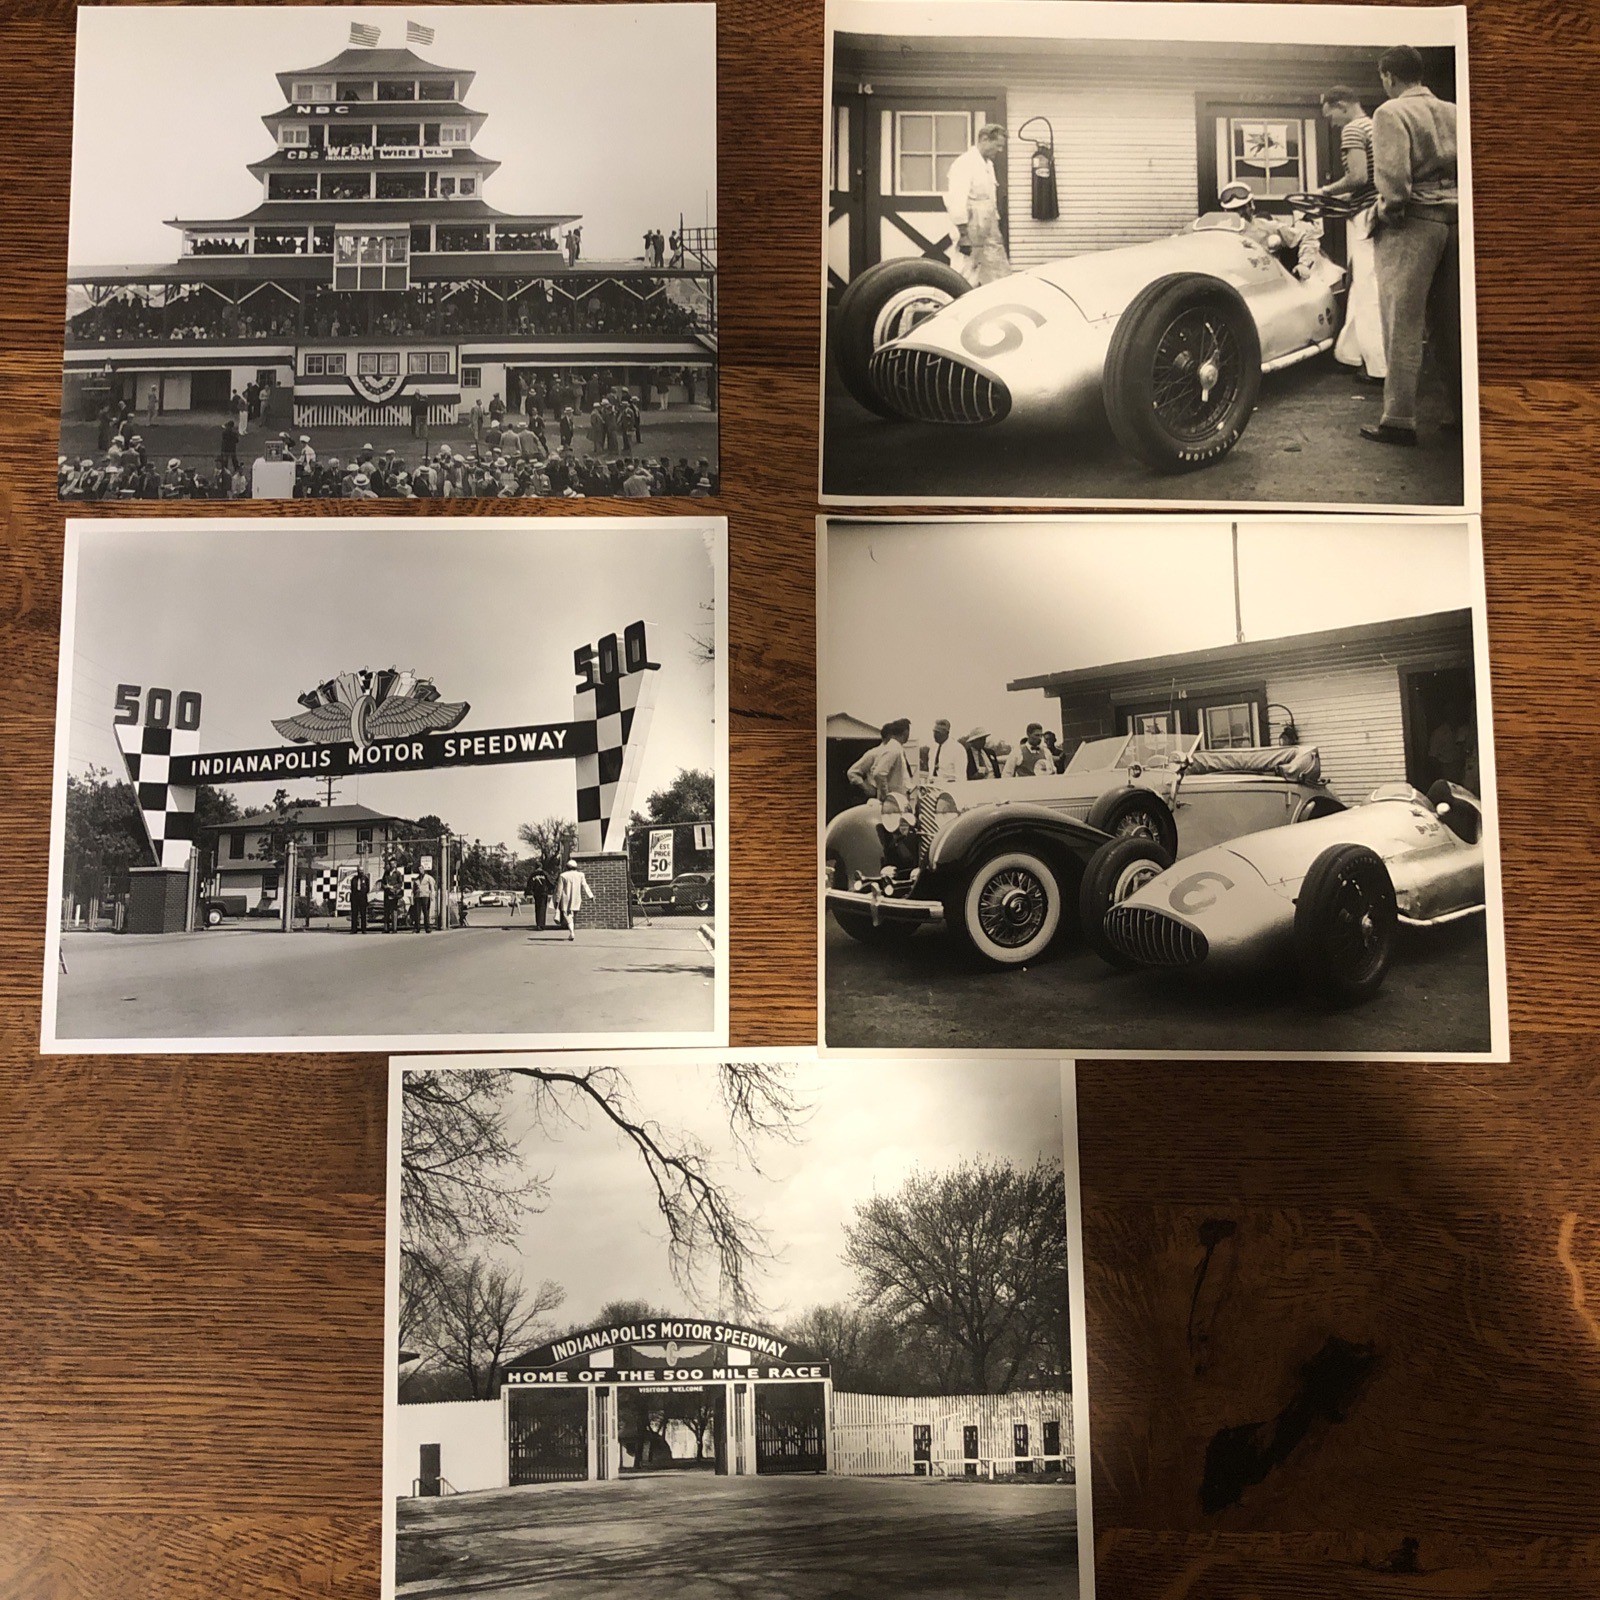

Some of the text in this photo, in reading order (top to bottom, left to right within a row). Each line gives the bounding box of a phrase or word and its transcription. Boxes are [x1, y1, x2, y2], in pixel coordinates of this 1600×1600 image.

[296, 106, 349, 114] NBC
[287, 150, 319, 159] CBS
[326, 145, 374, 156] WFBM
[960, 303, 1048, 360] 6
[573, 619, 661, 695] 500
[114, 683, 203, 732] 500
[190, 729, 568, 778] INDIANAPOLIS MOTOR SPEEDWAY
[653, 850, 671, 858] PRICE
[551, 1322, 788, 1362] INDIANAPOLIS MOTOR SPEEDWAY
[508, 1367, 822, 1382] HOME OF THE 500 MILE RACE
